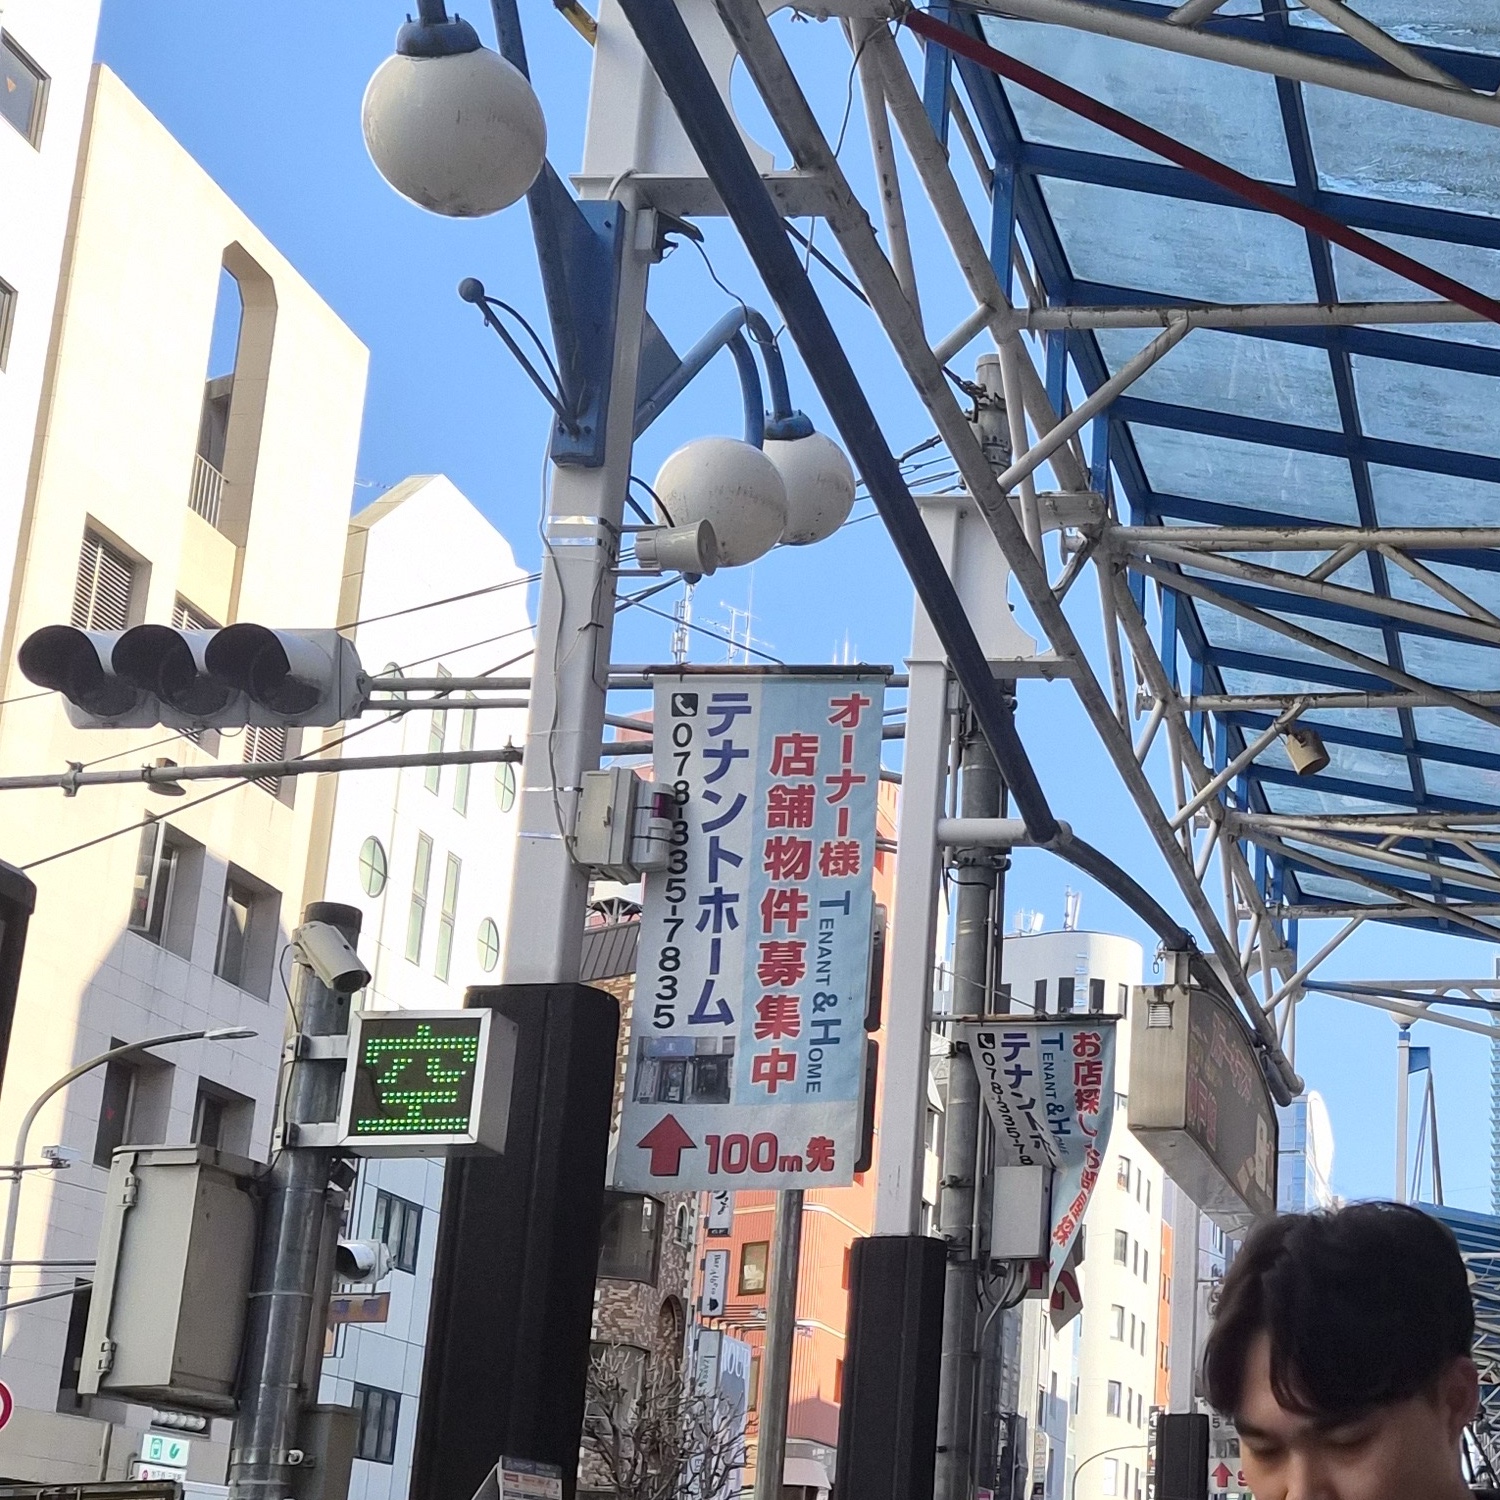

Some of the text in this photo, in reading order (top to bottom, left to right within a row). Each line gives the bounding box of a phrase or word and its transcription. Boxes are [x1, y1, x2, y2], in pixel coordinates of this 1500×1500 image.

[652, 723, 693, 1030] 078-335-7835
[688, 692, 752, 1026] テナントホーム
[819, 692, 870, 878] オーナー様
[751, 733, 819, 1095] 店舗物件募集中
[357, 1024, 477, 1132] 空
[705, 1132, 836, 1175] 100m先
